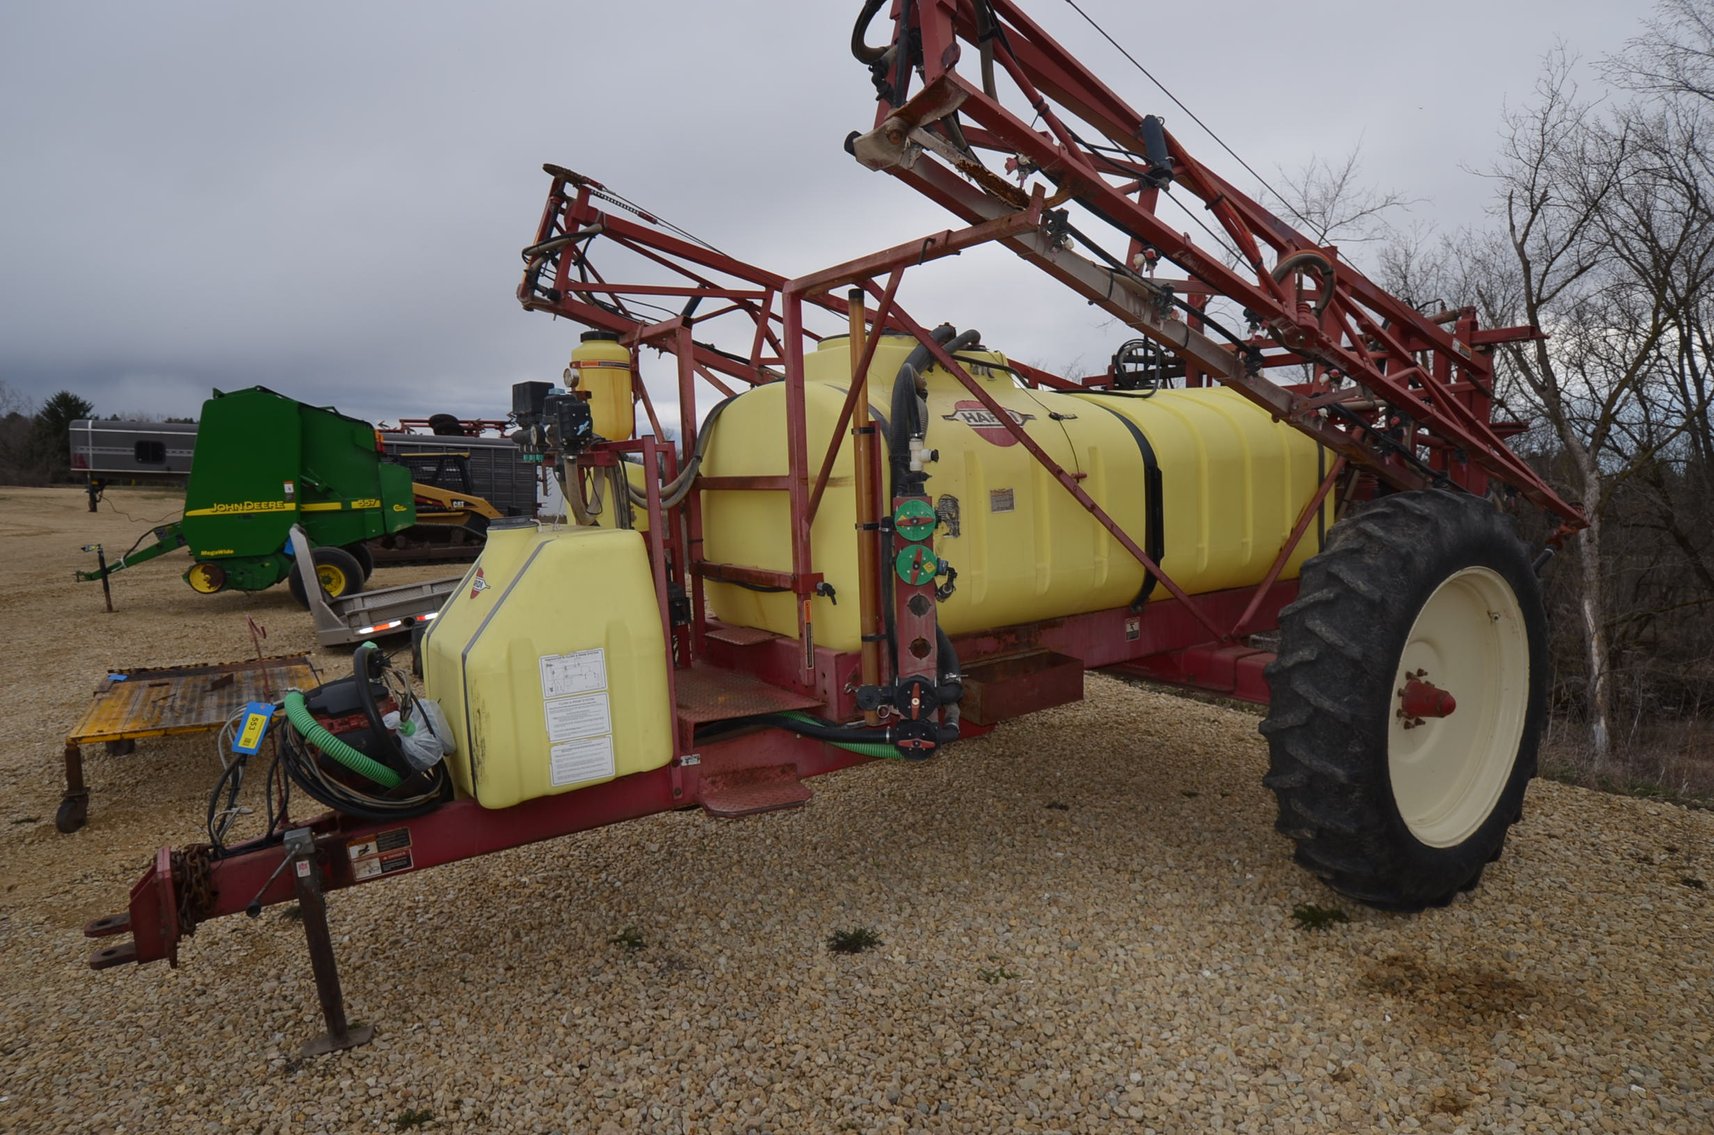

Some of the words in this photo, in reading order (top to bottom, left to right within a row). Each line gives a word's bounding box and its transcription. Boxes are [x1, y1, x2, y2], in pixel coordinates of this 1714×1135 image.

[211, 502, 242, 513] JOHN
[243, 500, 286, 511] DEERE
[357, 499, 376, 507] 557
[249, 717, 259, 731] 553
